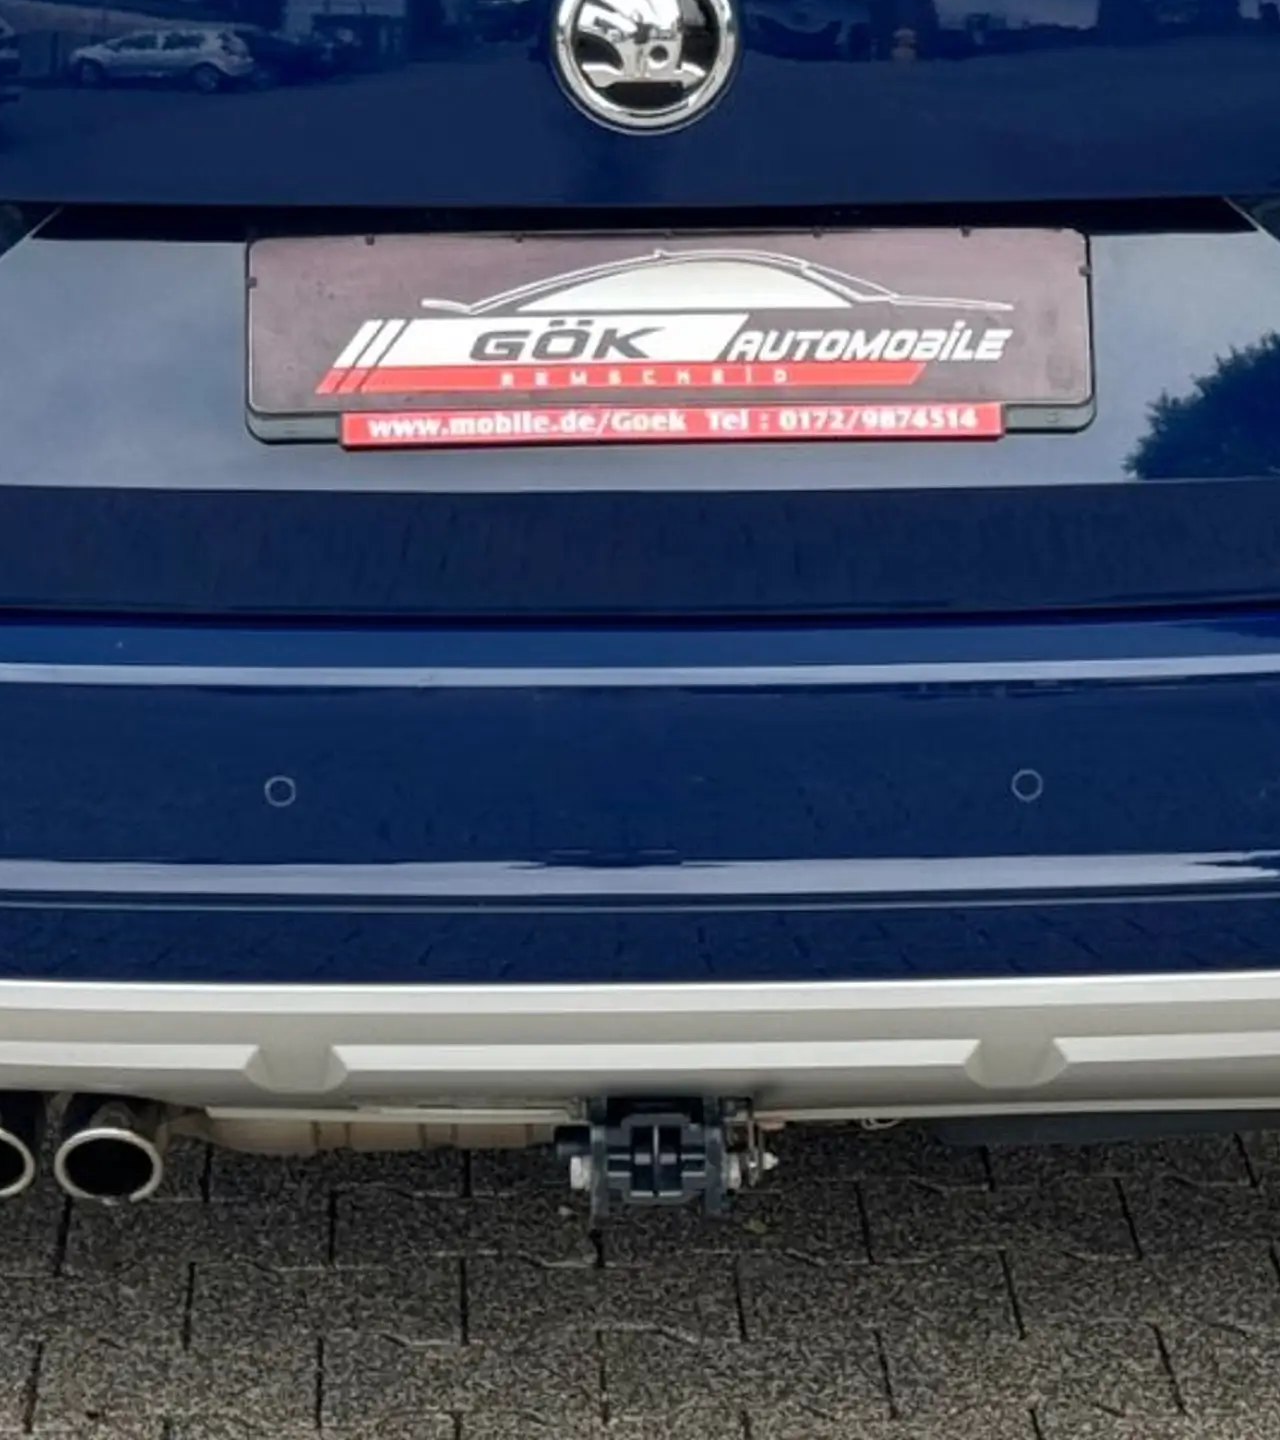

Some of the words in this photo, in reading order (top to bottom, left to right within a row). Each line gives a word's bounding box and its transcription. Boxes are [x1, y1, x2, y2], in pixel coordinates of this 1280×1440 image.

[469, 319, 666, 362] GÖK
[368, 409, 686, 439] www.mobile.de/Goek
[779, 407, 979, 431] 0172/9874514
